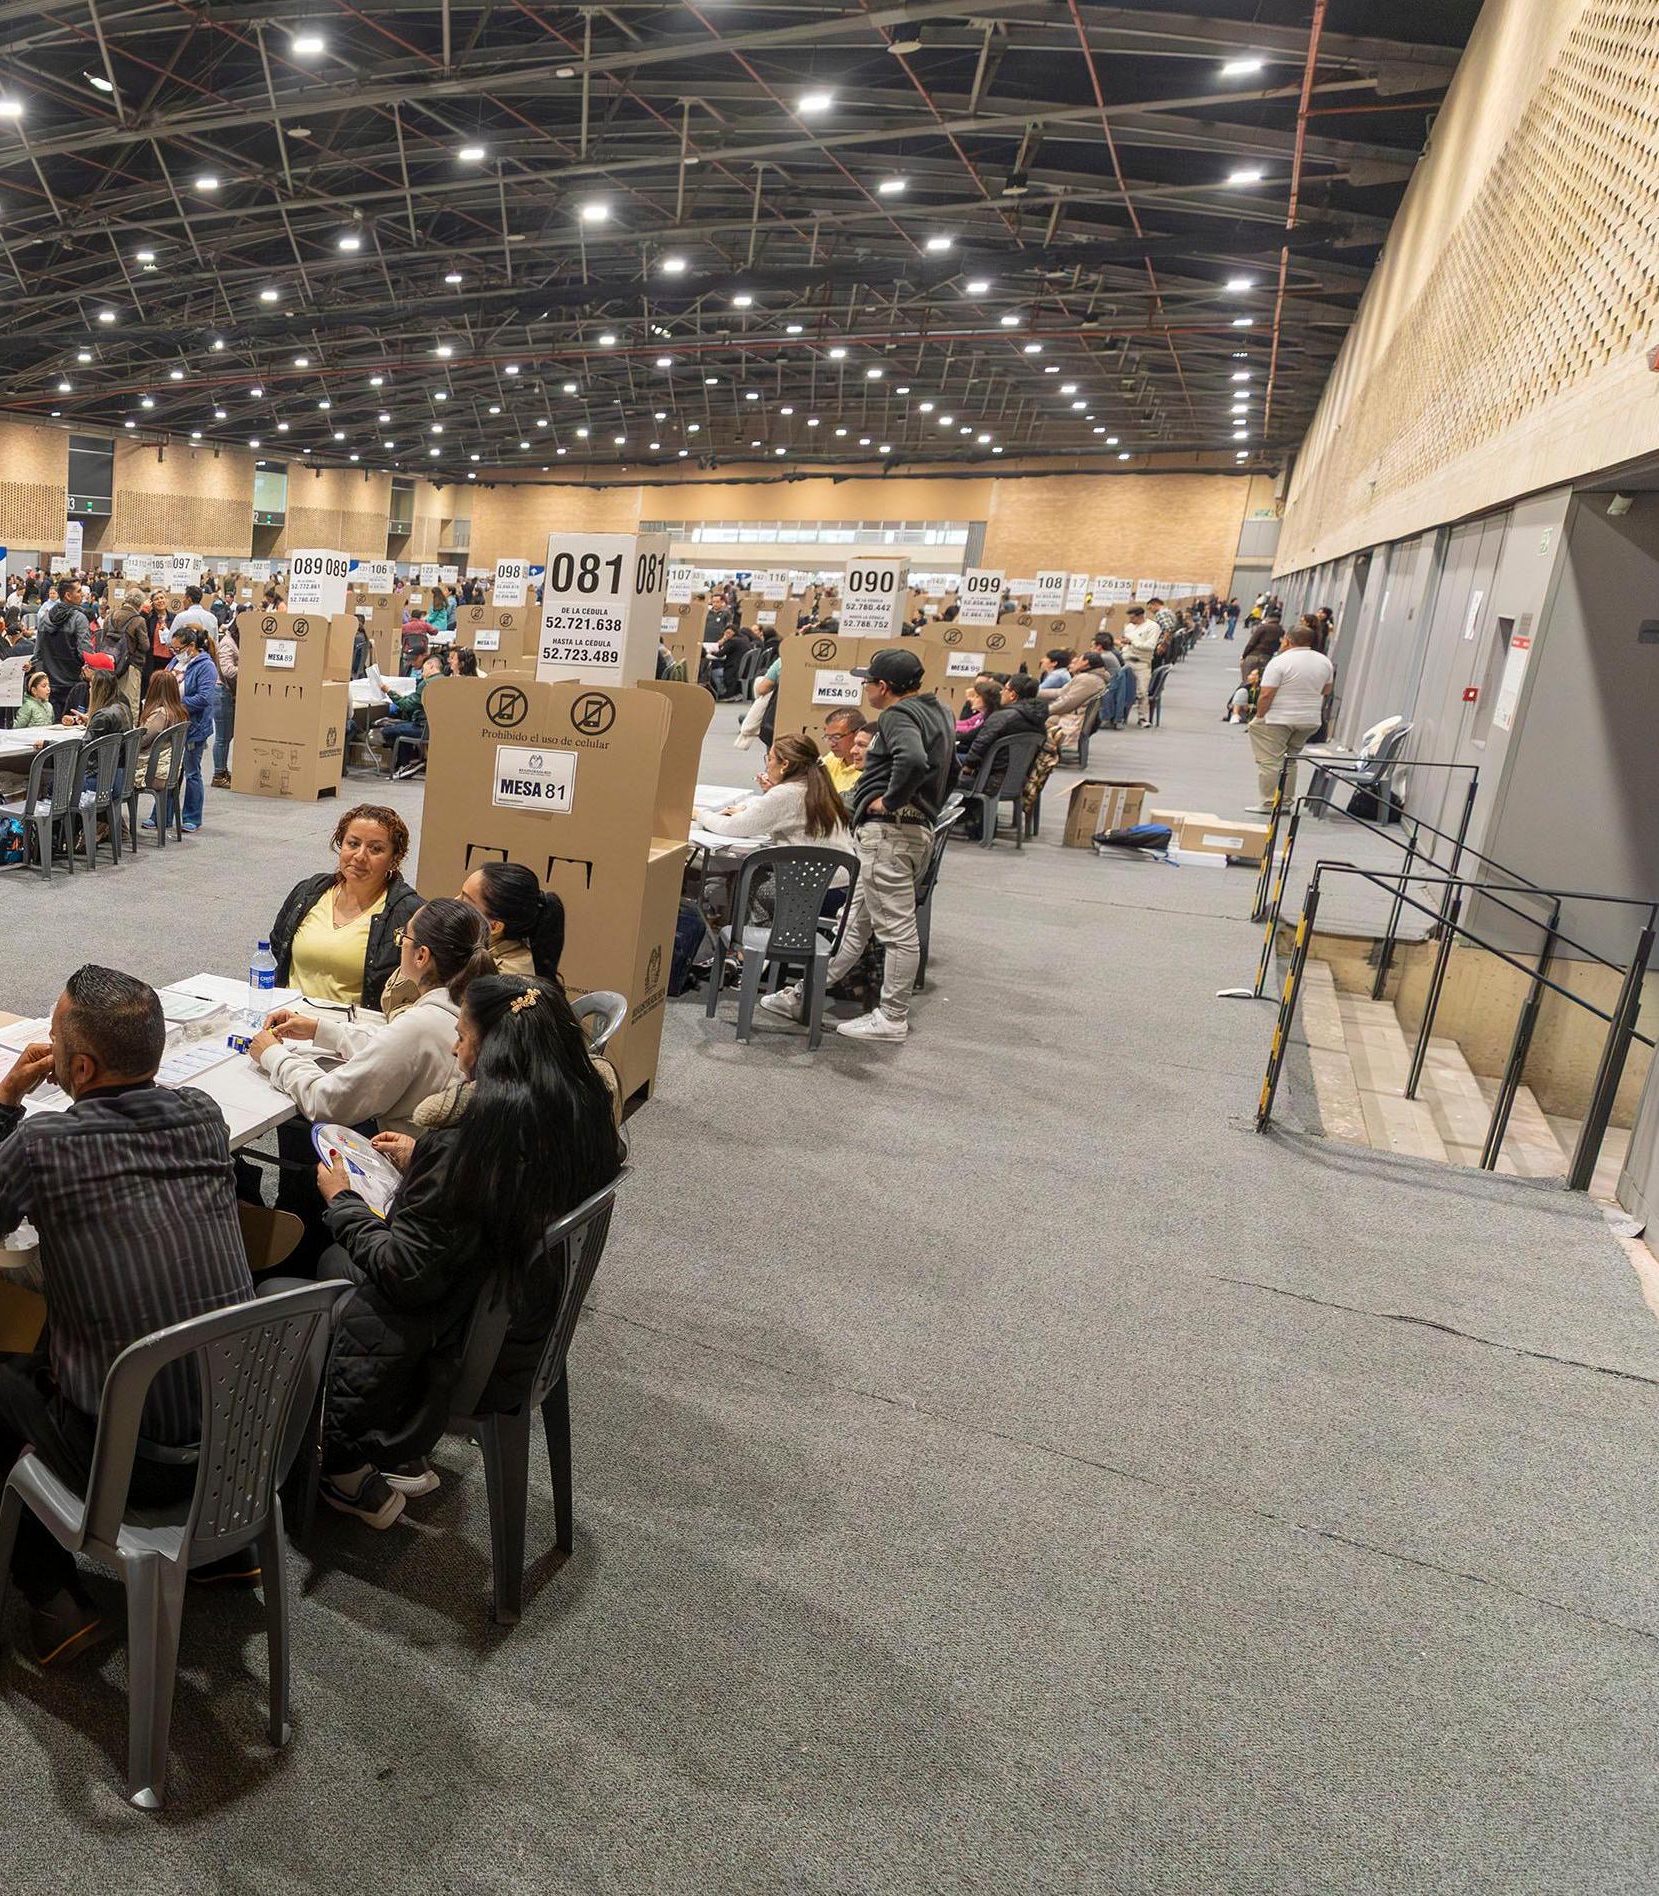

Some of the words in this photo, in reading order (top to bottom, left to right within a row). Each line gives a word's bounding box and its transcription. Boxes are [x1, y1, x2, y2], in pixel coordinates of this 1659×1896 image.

[152, 560, 164, 570] 105
[172, 558, 191, 570] 097
[294, 558, 323, 575] 089
[326, 558, 348, 578] 089
[372, 564, 388, 574] 106
[498, 564, 521, 579] 098
[550, 552, 624, 595] 081
[636, 552, 666, 596] 081
[672, 570, 692, 580] 107
[770, 573, 786, 582] 116
[848, 570, 894, 593] 090
[968, 576, 1001, 593] 099
[1038, 576, 1063, 590] 108
[1114, 580, 1132, 589] 135
[546, 616, 622, 632] 52.721.638
[542, 647, 618, 663] 52.723.489
[818, 688, 843, 697] MESA
[844, 689, 858, 698] 90
[482, 728, 528, 742] Prohibido
[530, 732, 539, 743] el
[560, 736, 572, 746] de
[575, 738, 610, 750] celular
[500, 778, 542, 798] MESA
[545, 783, 566, 800] 81
